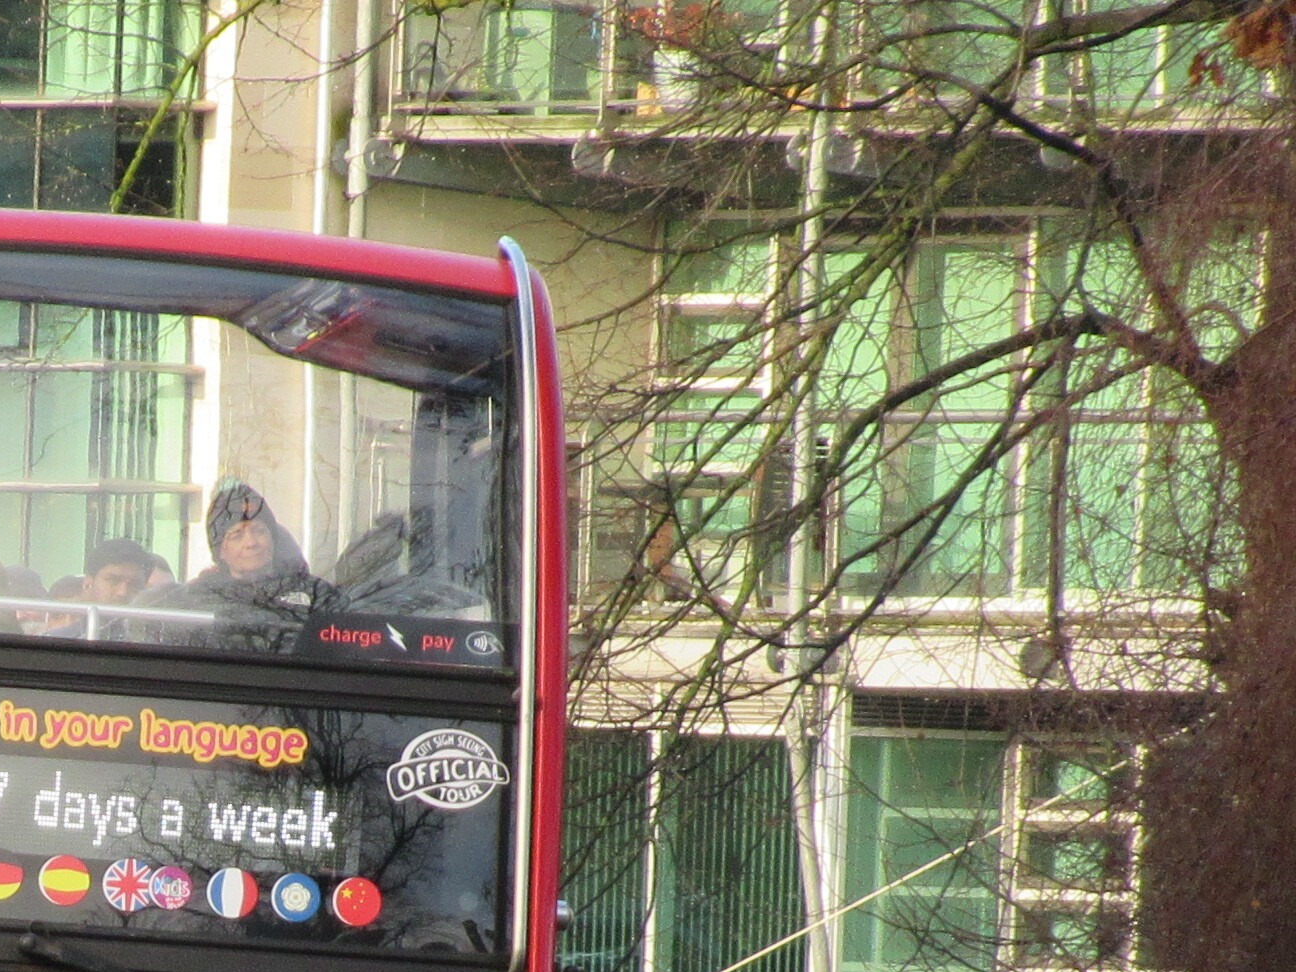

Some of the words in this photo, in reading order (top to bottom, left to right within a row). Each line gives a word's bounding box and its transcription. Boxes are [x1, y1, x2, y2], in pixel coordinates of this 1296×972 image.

[319, 624, 382, 648] charge
[422, 632, 455, 653] pay
[0, 700, 36, 743] in
[41, 708, 132, 750] your
[140, 709, 309, 768] language
[397, 759, 505, 792] OFFICIAL
[439, 783, 483, 803] TOUR
[34, 770, 137, 847] days
[160, 796, 183, 838] a
[208, 790, 339, 850] week
[154, 876, 191, 898] Kids
